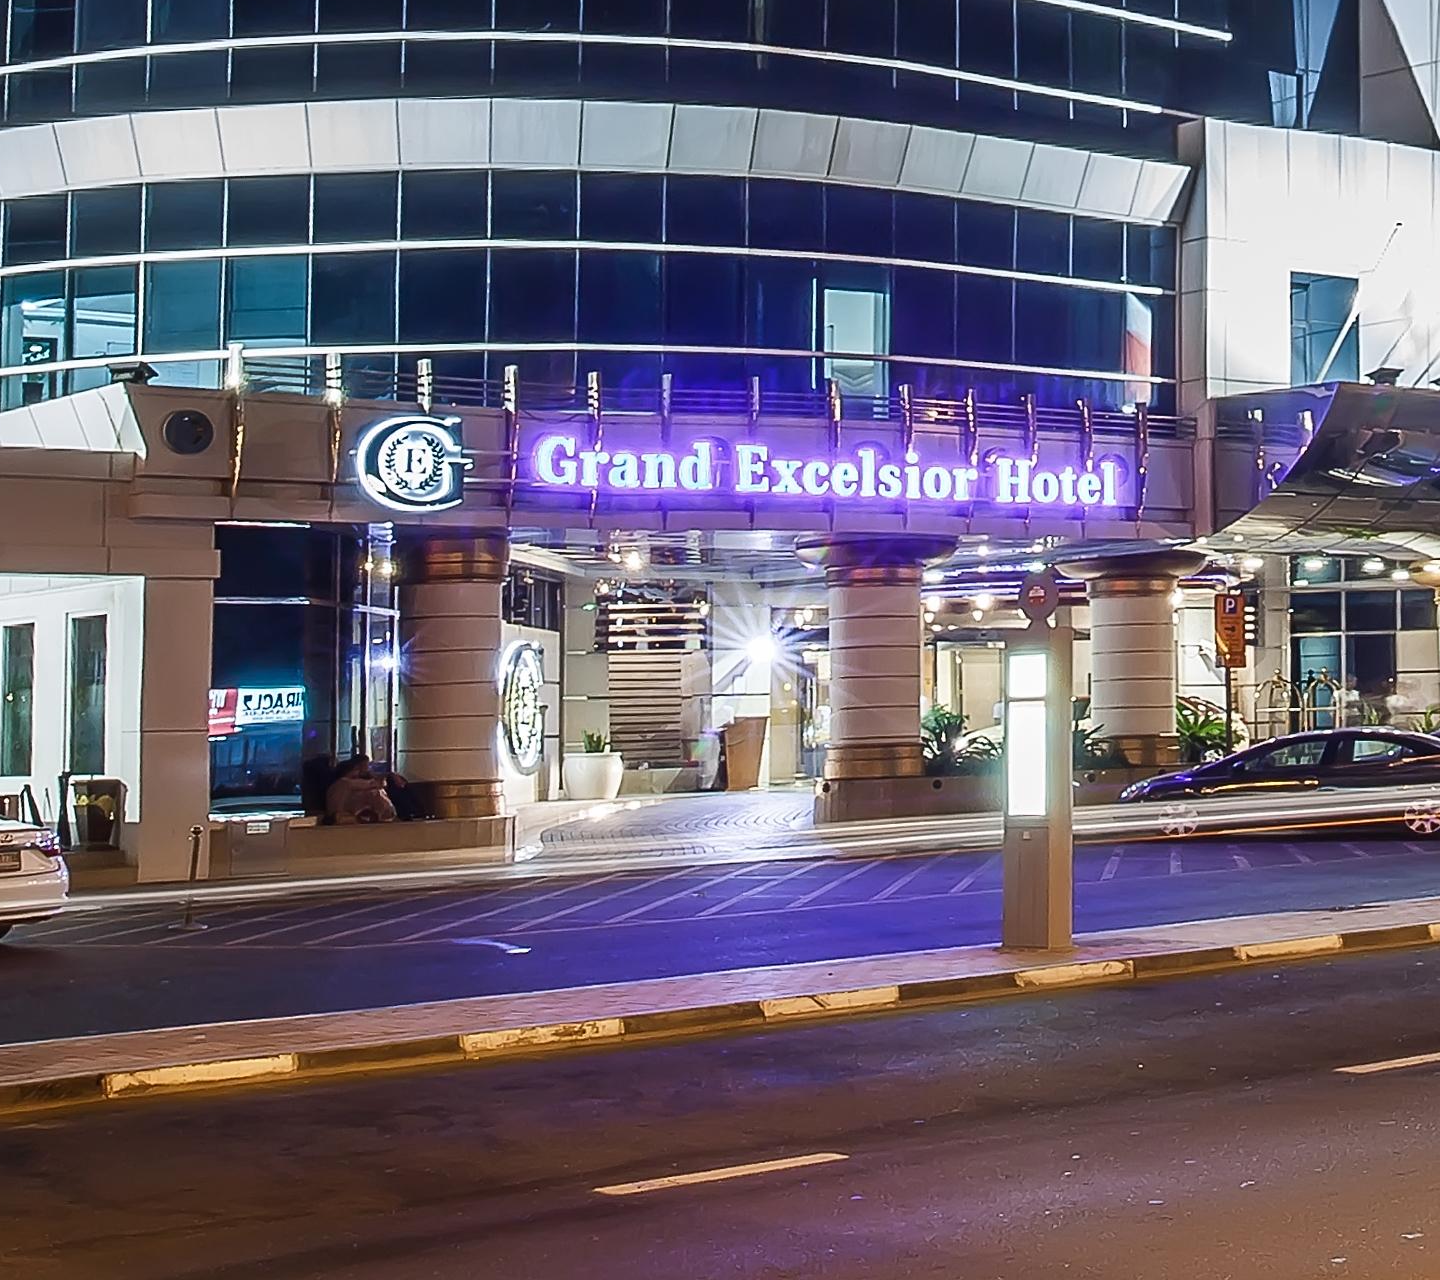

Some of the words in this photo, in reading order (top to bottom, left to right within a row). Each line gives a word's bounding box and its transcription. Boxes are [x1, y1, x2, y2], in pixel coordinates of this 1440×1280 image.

[535, 435, 713, 490] Grand
[735, 444, 978, 500] Excelsior
[994, 457, 1118, 506] Hotel
[1225, 598, 1235, 613] P
